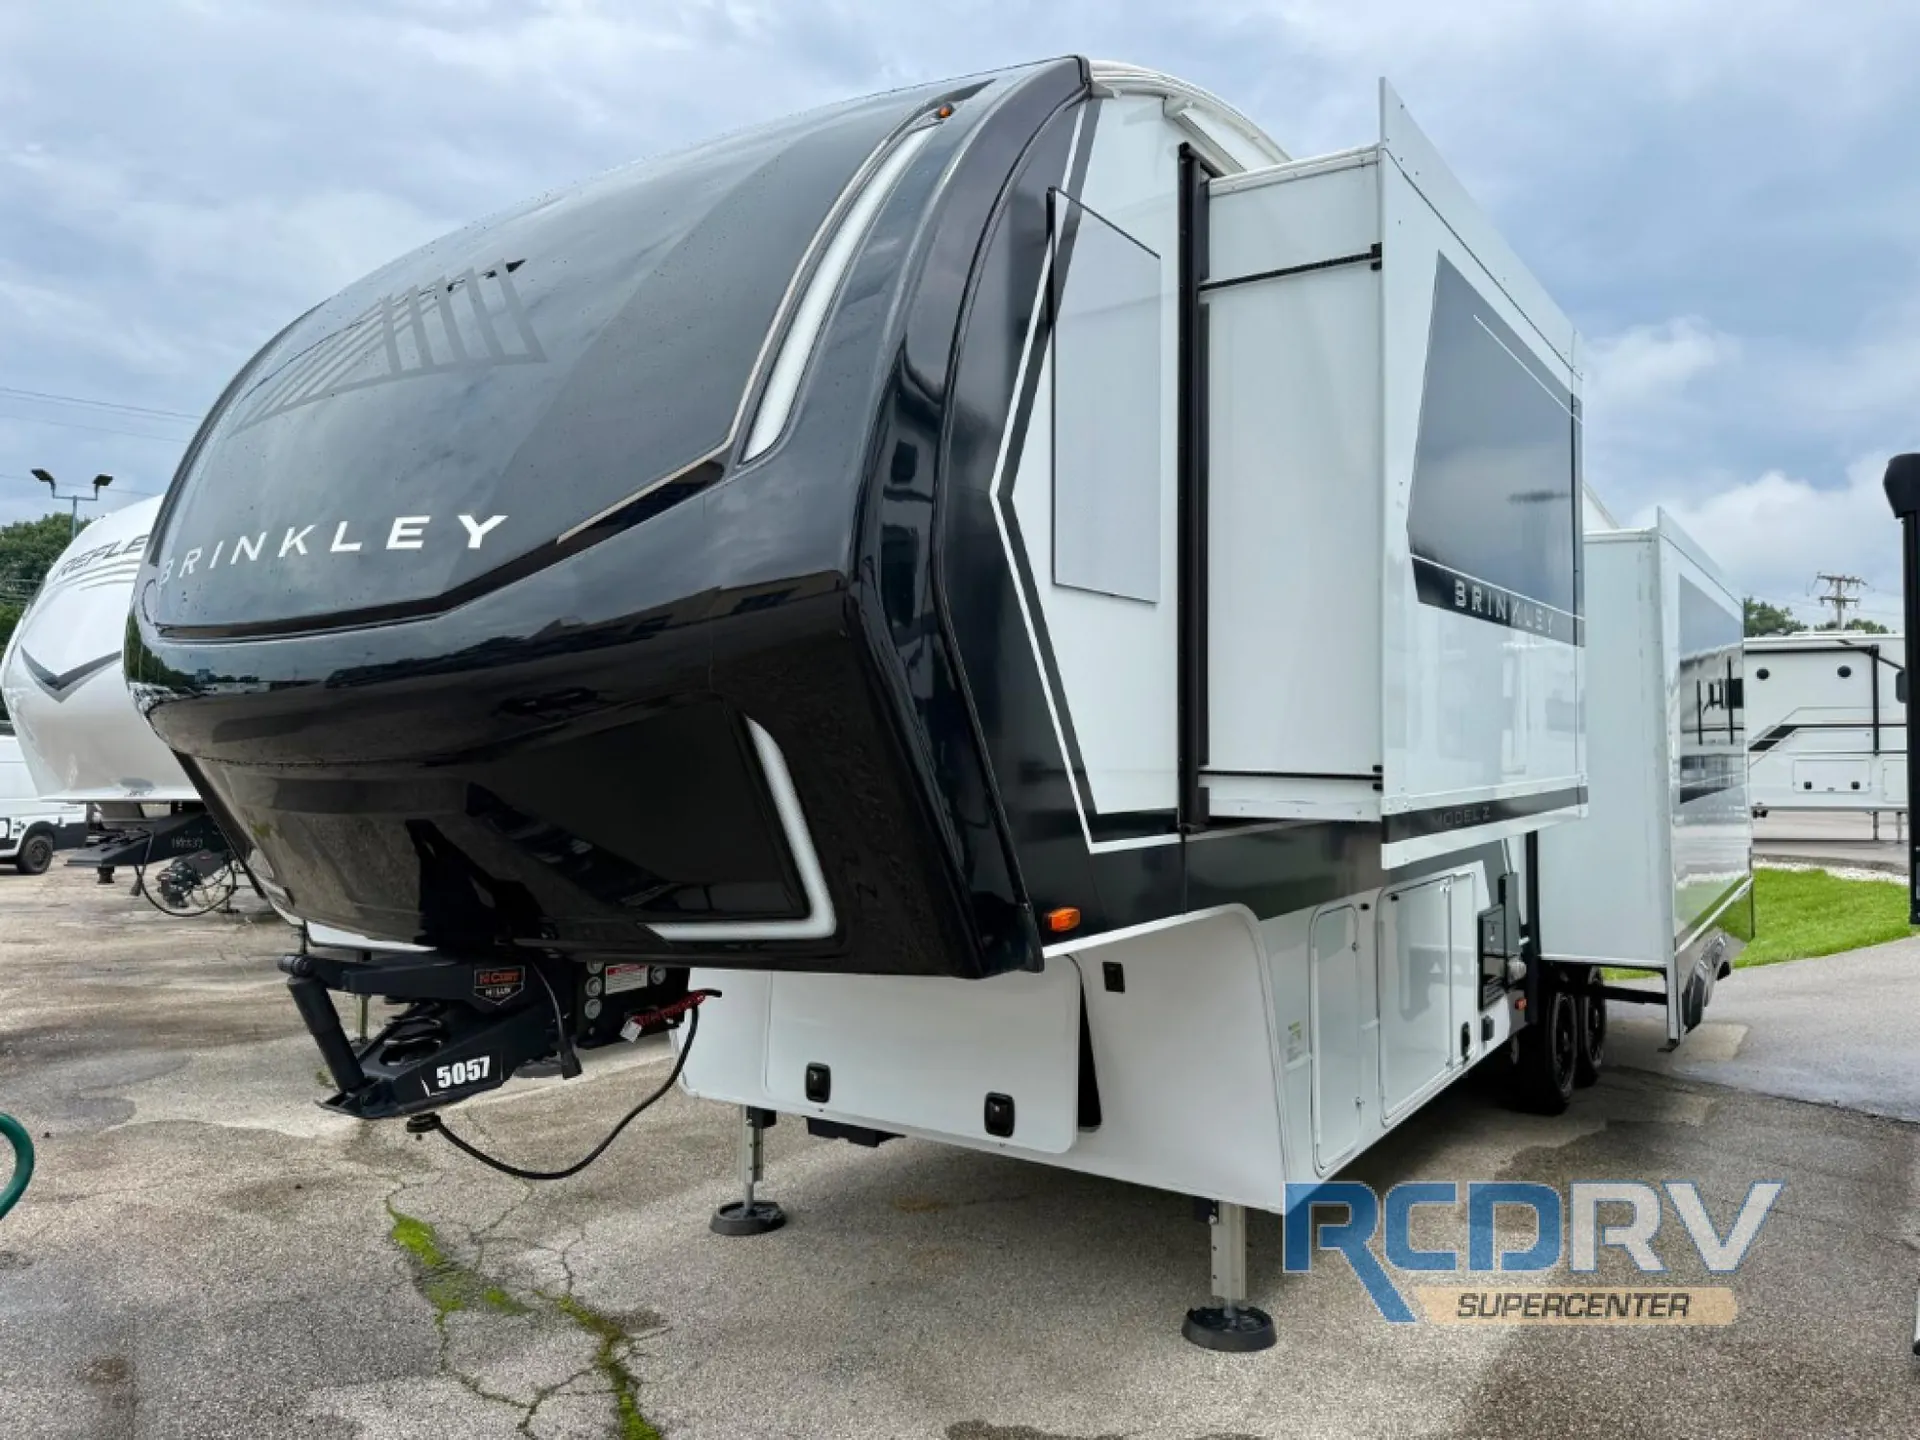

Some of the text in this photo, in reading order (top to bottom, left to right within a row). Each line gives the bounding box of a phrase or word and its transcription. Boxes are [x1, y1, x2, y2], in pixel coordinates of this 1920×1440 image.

[159, 515, 509, 587] BRINKLEY
[1454, 579, 1554, 635] BRINKLEY
[436, 1055, 490, 1089] 5057
